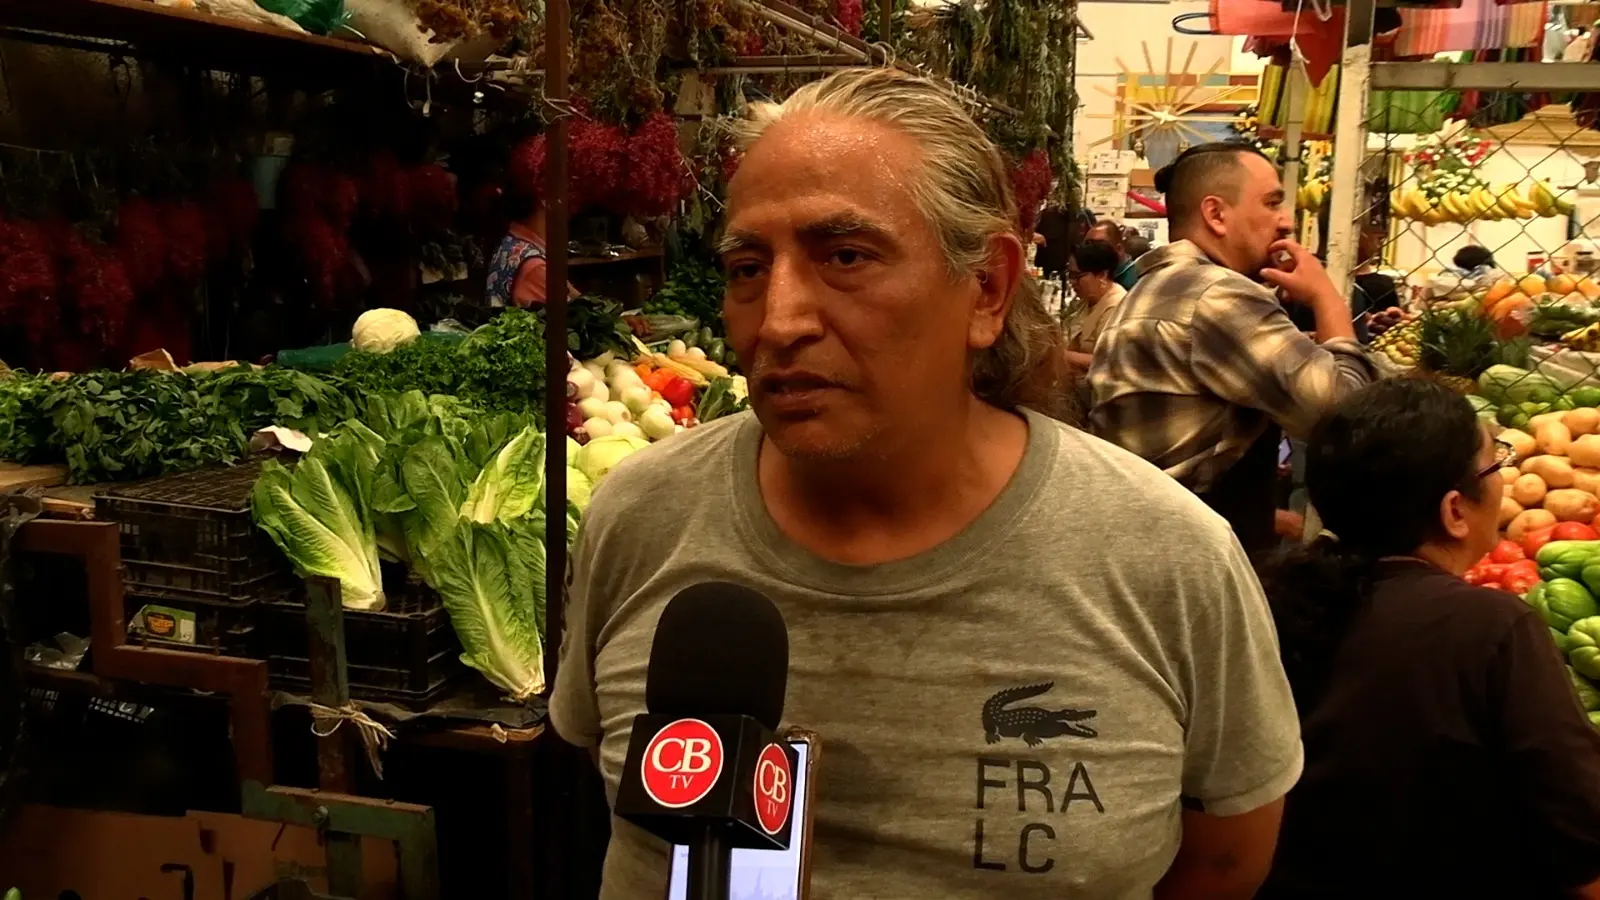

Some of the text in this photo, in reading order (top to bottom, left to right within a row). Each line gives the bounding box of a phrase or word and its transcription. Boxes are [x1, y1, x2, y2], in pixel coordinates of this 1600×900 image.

[652, 738, 712, 773] CB
[669, 775, 694, 789] TV
[759, 760, 787, 803] CB
[976, 758, 1105, 813] FRA
[767, 800, 779, 817] TV
[974, 818, 1056, 874] LC
